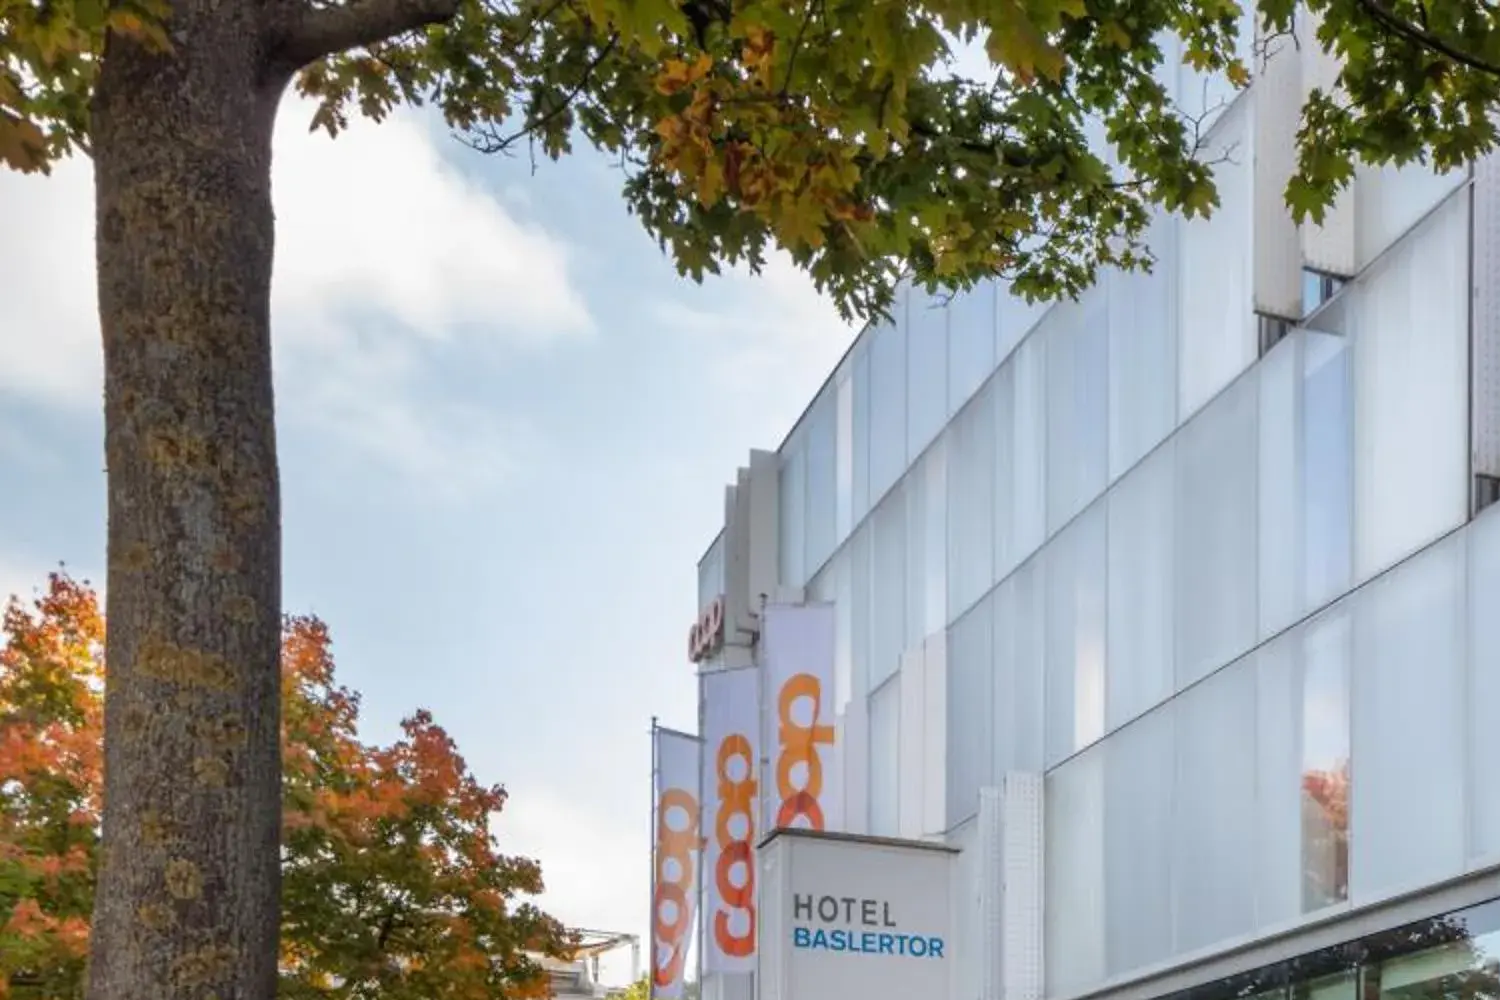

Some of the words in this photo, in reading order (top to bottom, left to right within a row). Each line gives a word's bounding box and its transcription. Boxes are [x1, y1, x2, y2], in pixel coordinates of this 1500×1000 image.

[776, 673, 835, 835] oop
[714, 733, 758, 958] coop
[793, 894, 897, 927] HOTEL
[793, 928, 944, 958] BASLERTOR
